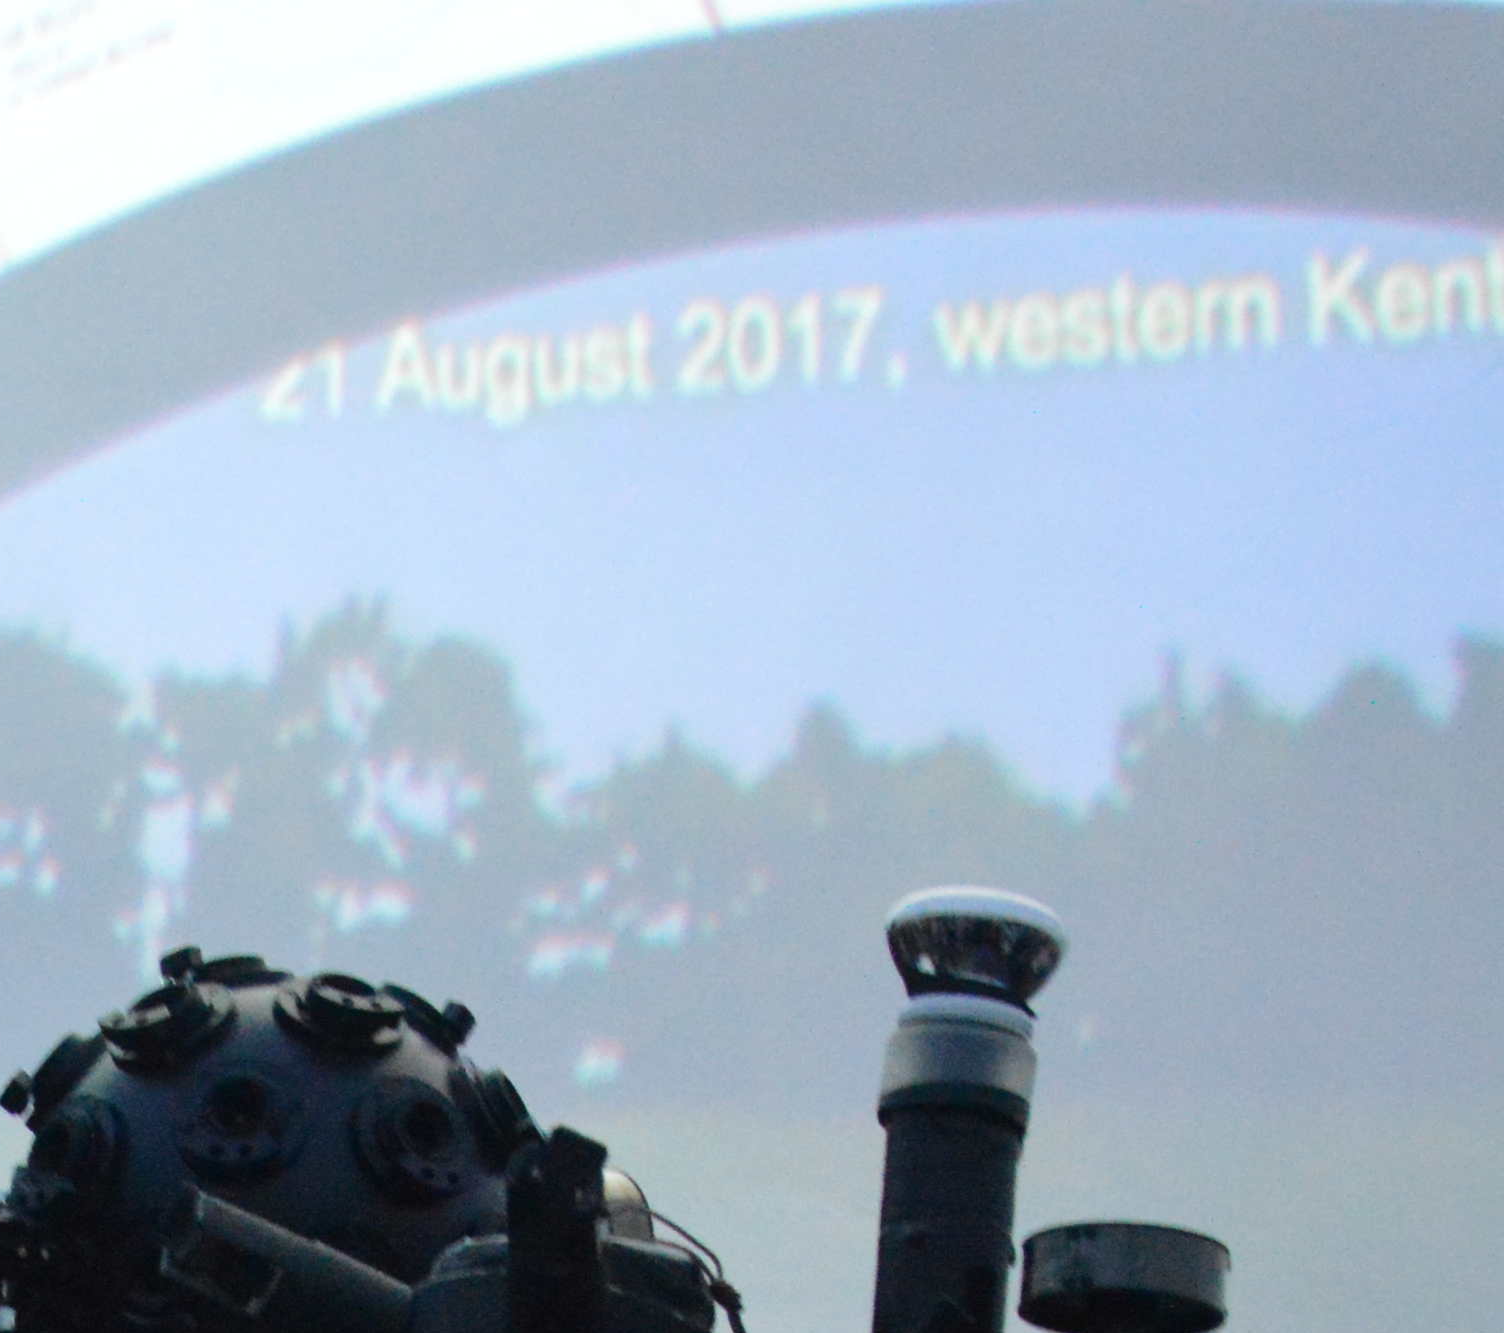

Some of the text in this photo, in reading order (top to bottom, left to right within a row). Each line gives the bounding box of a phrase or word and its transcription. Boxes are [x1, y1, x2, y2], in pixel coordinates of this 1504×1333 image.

[378, 316, 652, 428] August
[676, 284, 908, 390] 2017,
[934, 272, 1279, 374] western
